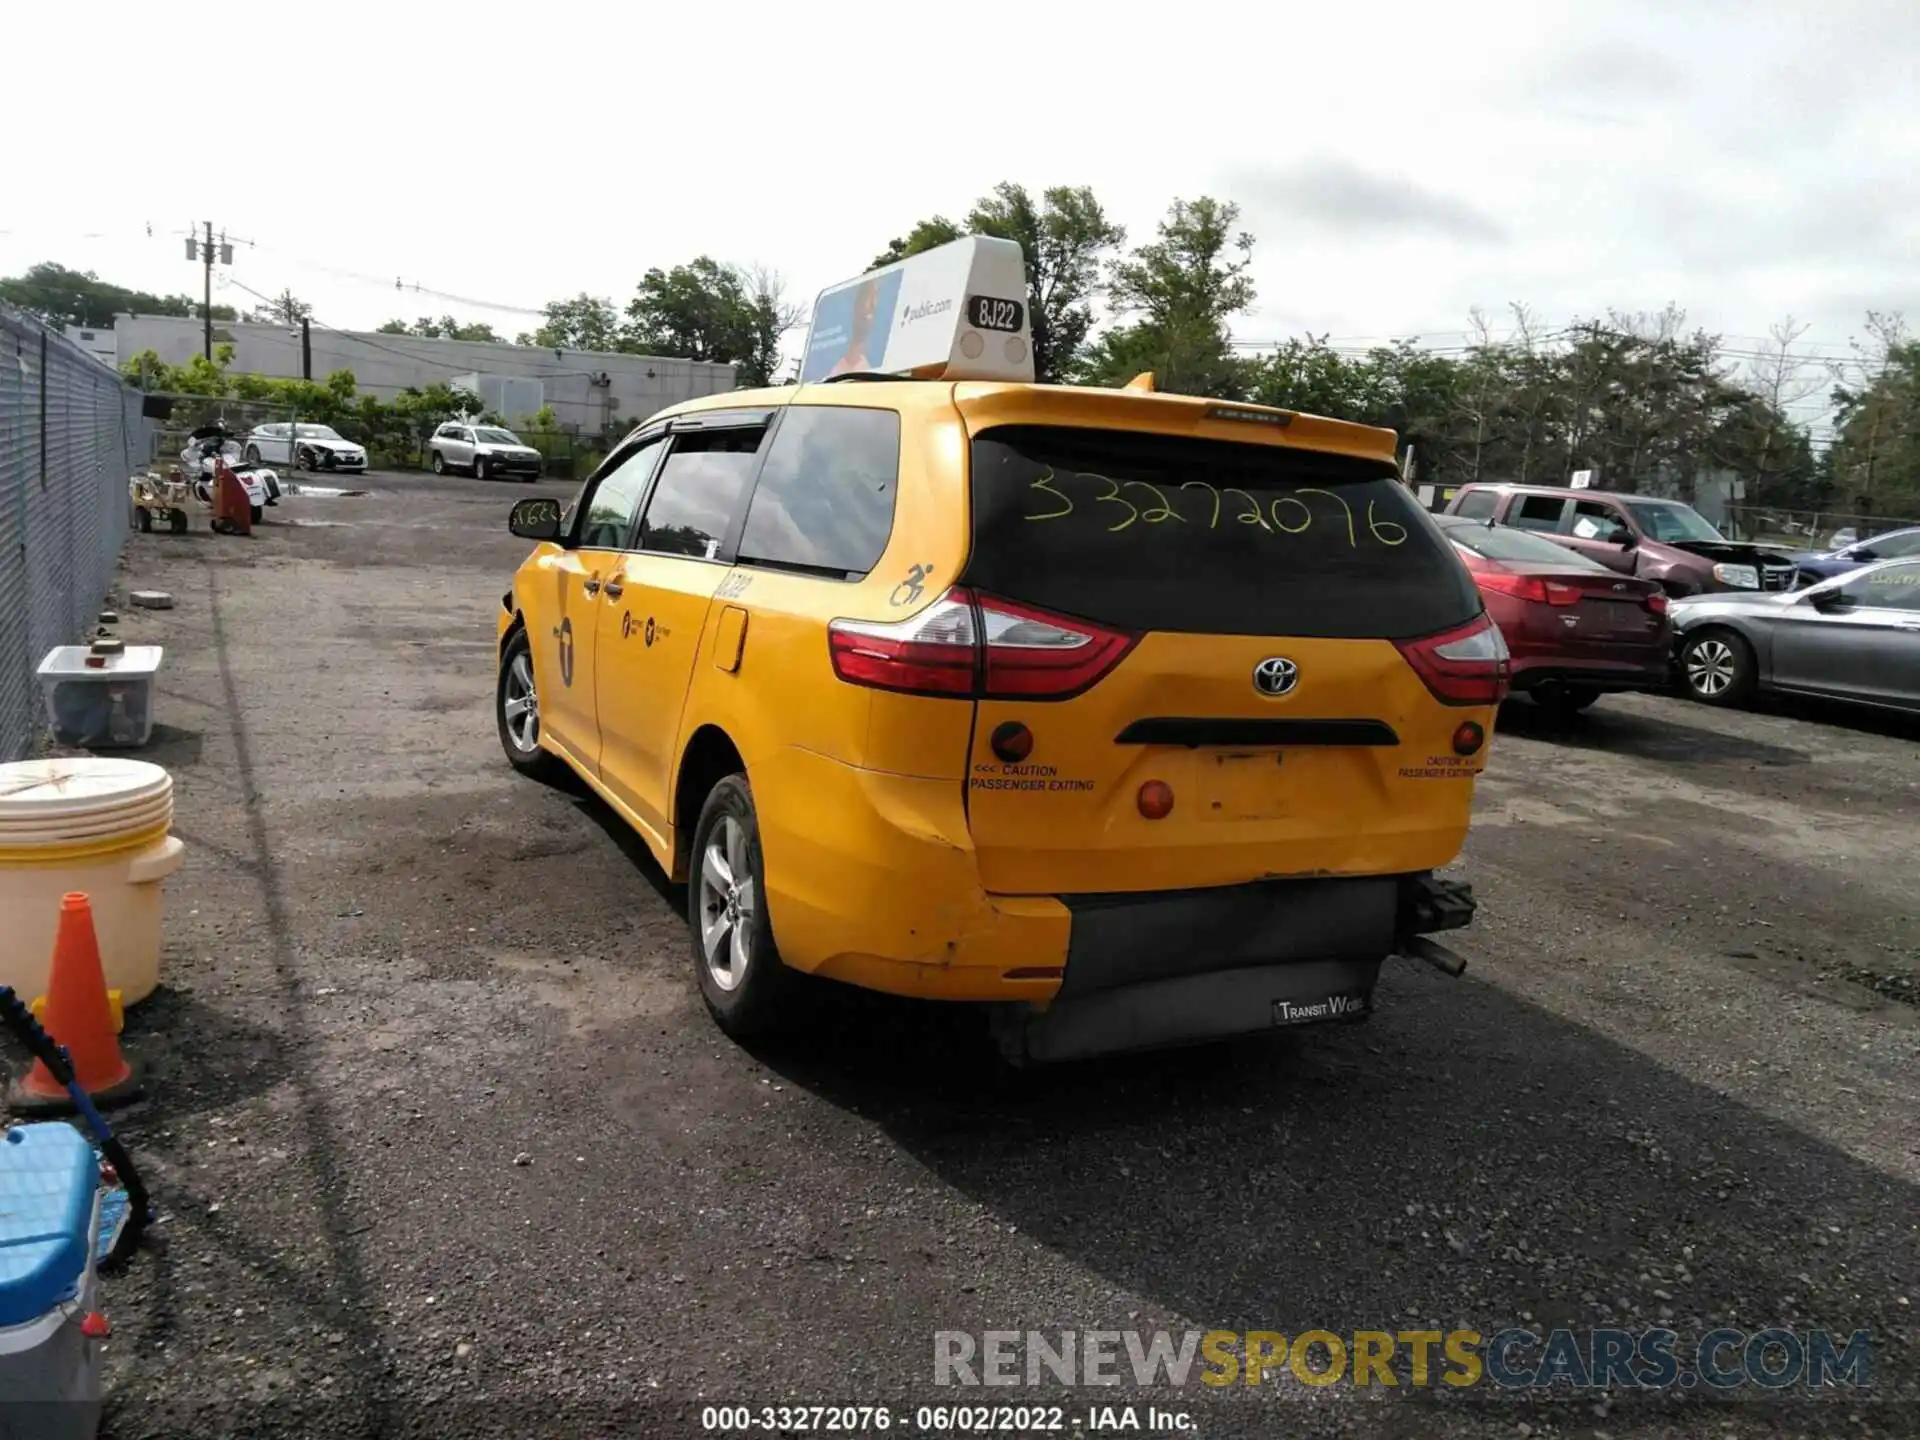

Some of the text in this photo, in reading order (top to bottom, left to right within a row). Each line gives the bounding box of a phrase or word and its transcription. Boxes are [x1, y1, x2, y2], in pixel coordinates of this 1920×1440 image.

[979, 299, 1016, 329] 8J22
[1025, 464, 1407, 547] 33272076
[1002, 765, 1057, 777] CAUTION
[971, 778, 1095, 791] PASSENGER EXITING
